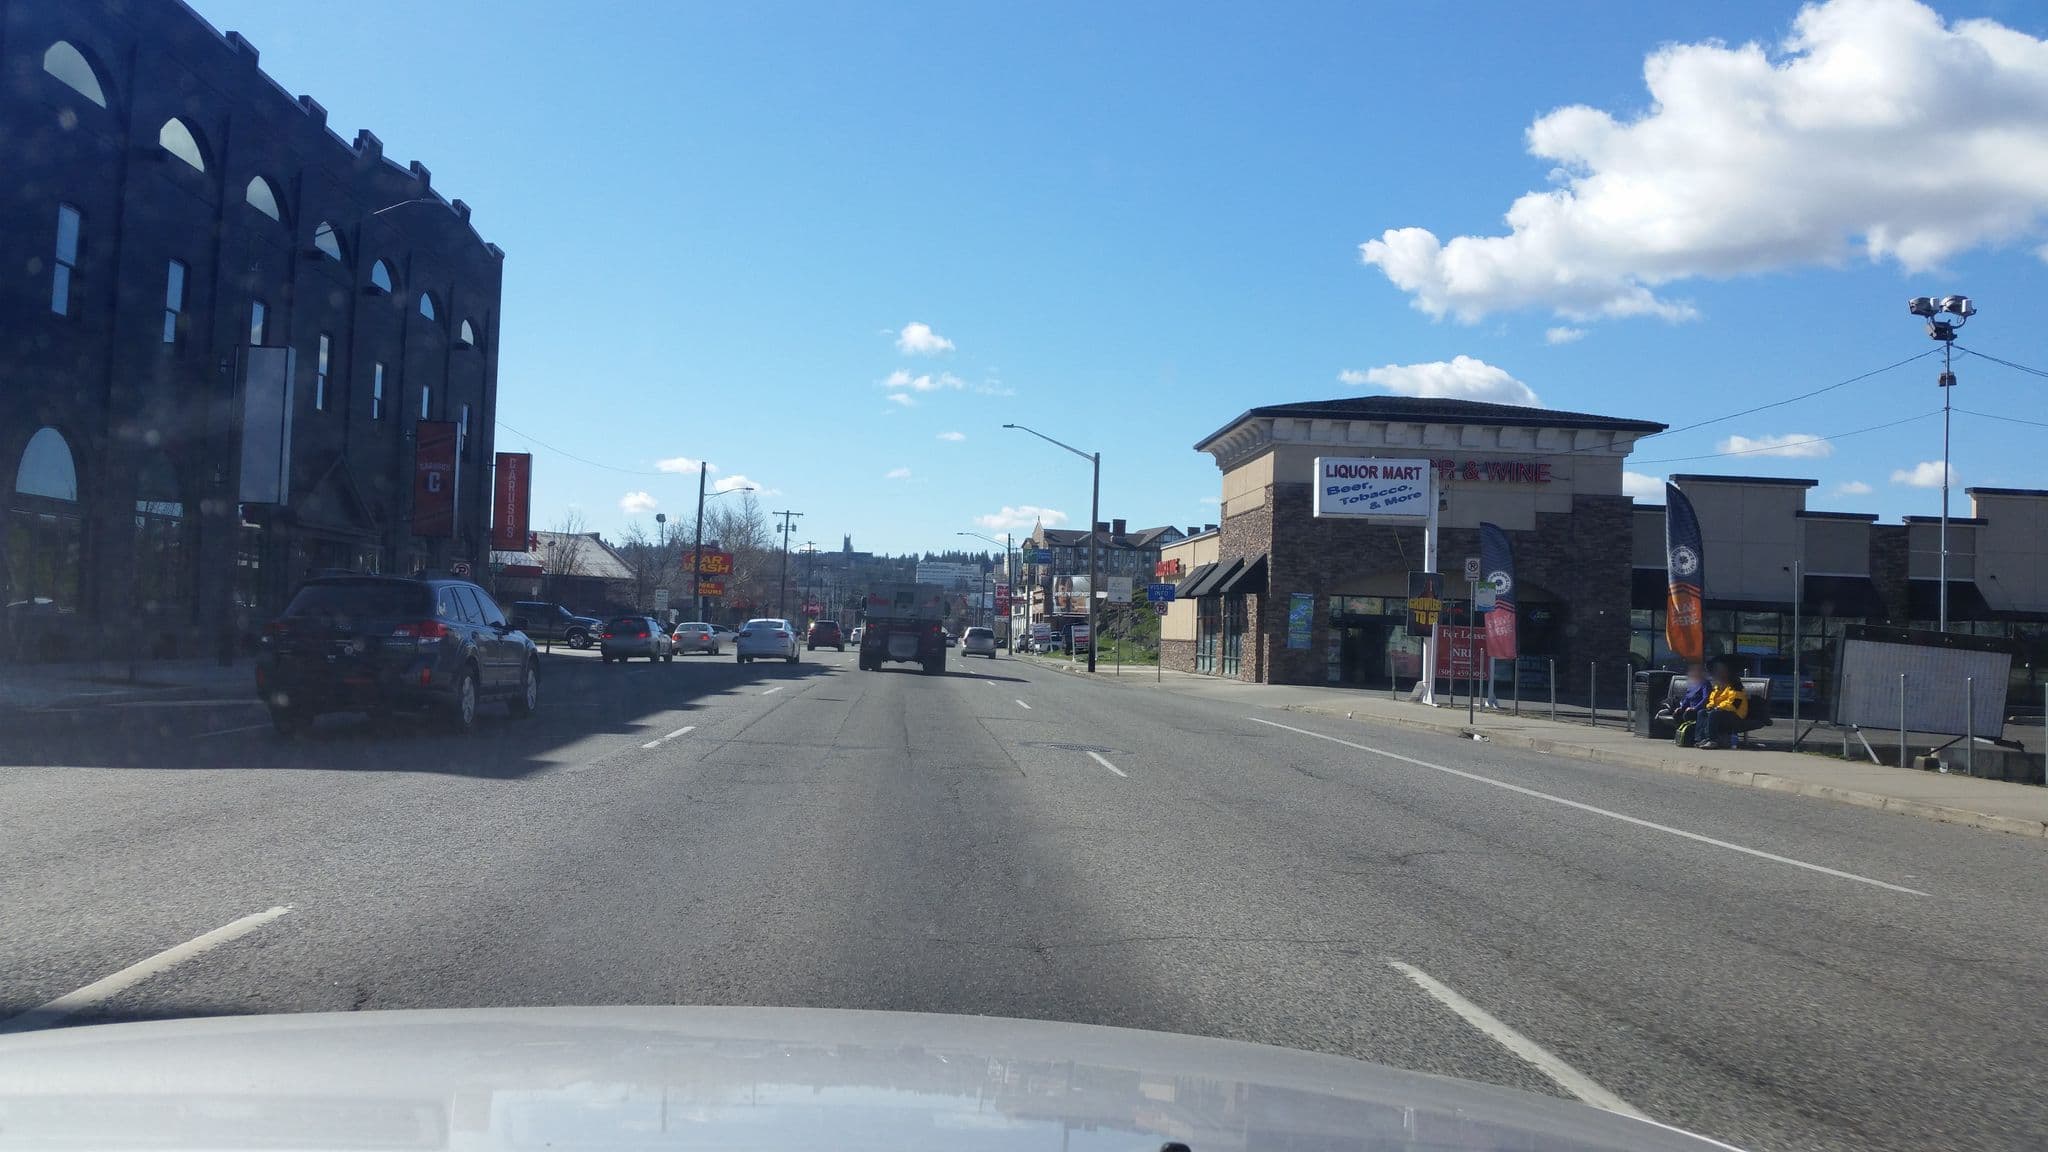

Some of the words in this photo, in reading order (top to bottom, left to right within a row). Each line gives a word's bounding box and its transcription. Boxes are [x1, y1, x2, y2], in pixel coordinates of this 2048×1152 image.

[1325, 464, 1378, 479] LIQUOR
[1382, 465, 1423, 480] MART
[1487, 460, 1552, 483] WINE
[1385, 492, 1423, 506] More
[1443, 629, 1458, 639] For
